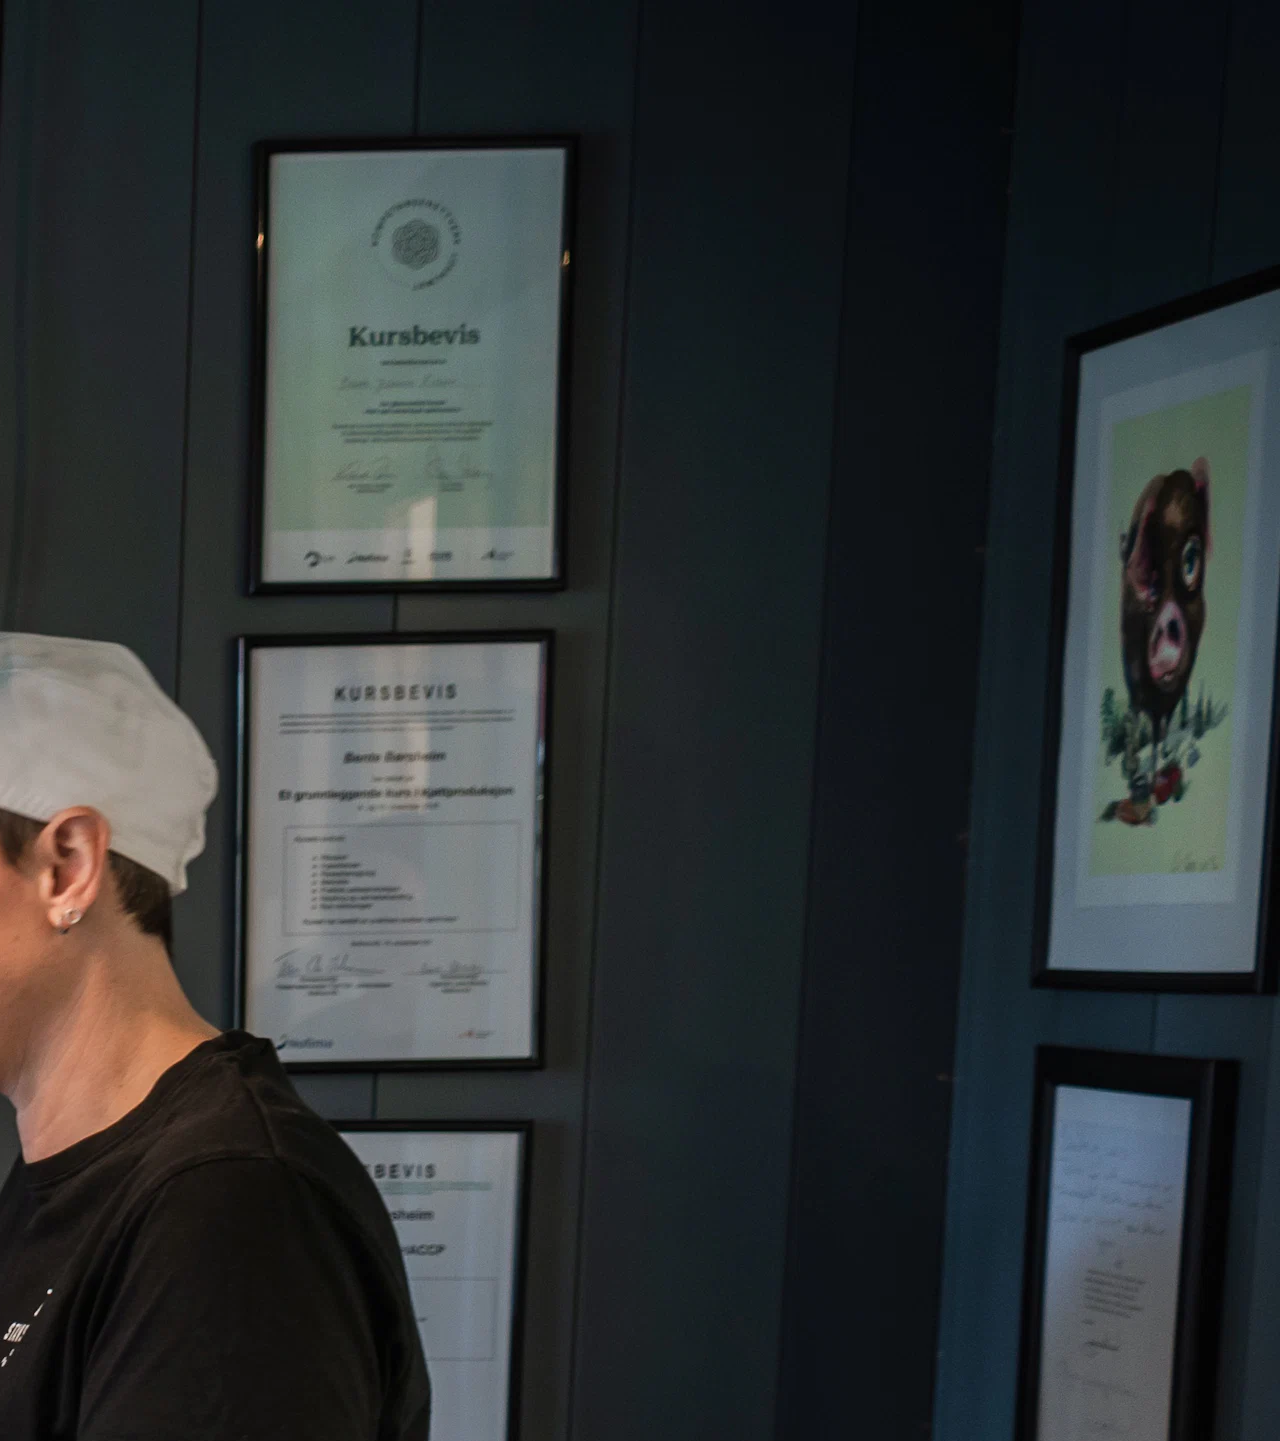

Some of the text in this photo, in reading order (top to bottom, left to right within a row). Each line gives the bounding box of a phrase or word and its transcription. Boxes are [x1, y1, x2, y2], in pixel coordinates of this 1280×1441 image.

[348, 324, 481, 348] Kursbevis
[334, 684, 458, 702] KURSBEVIS
[366, 1163, 437, 1179] BEVIS
